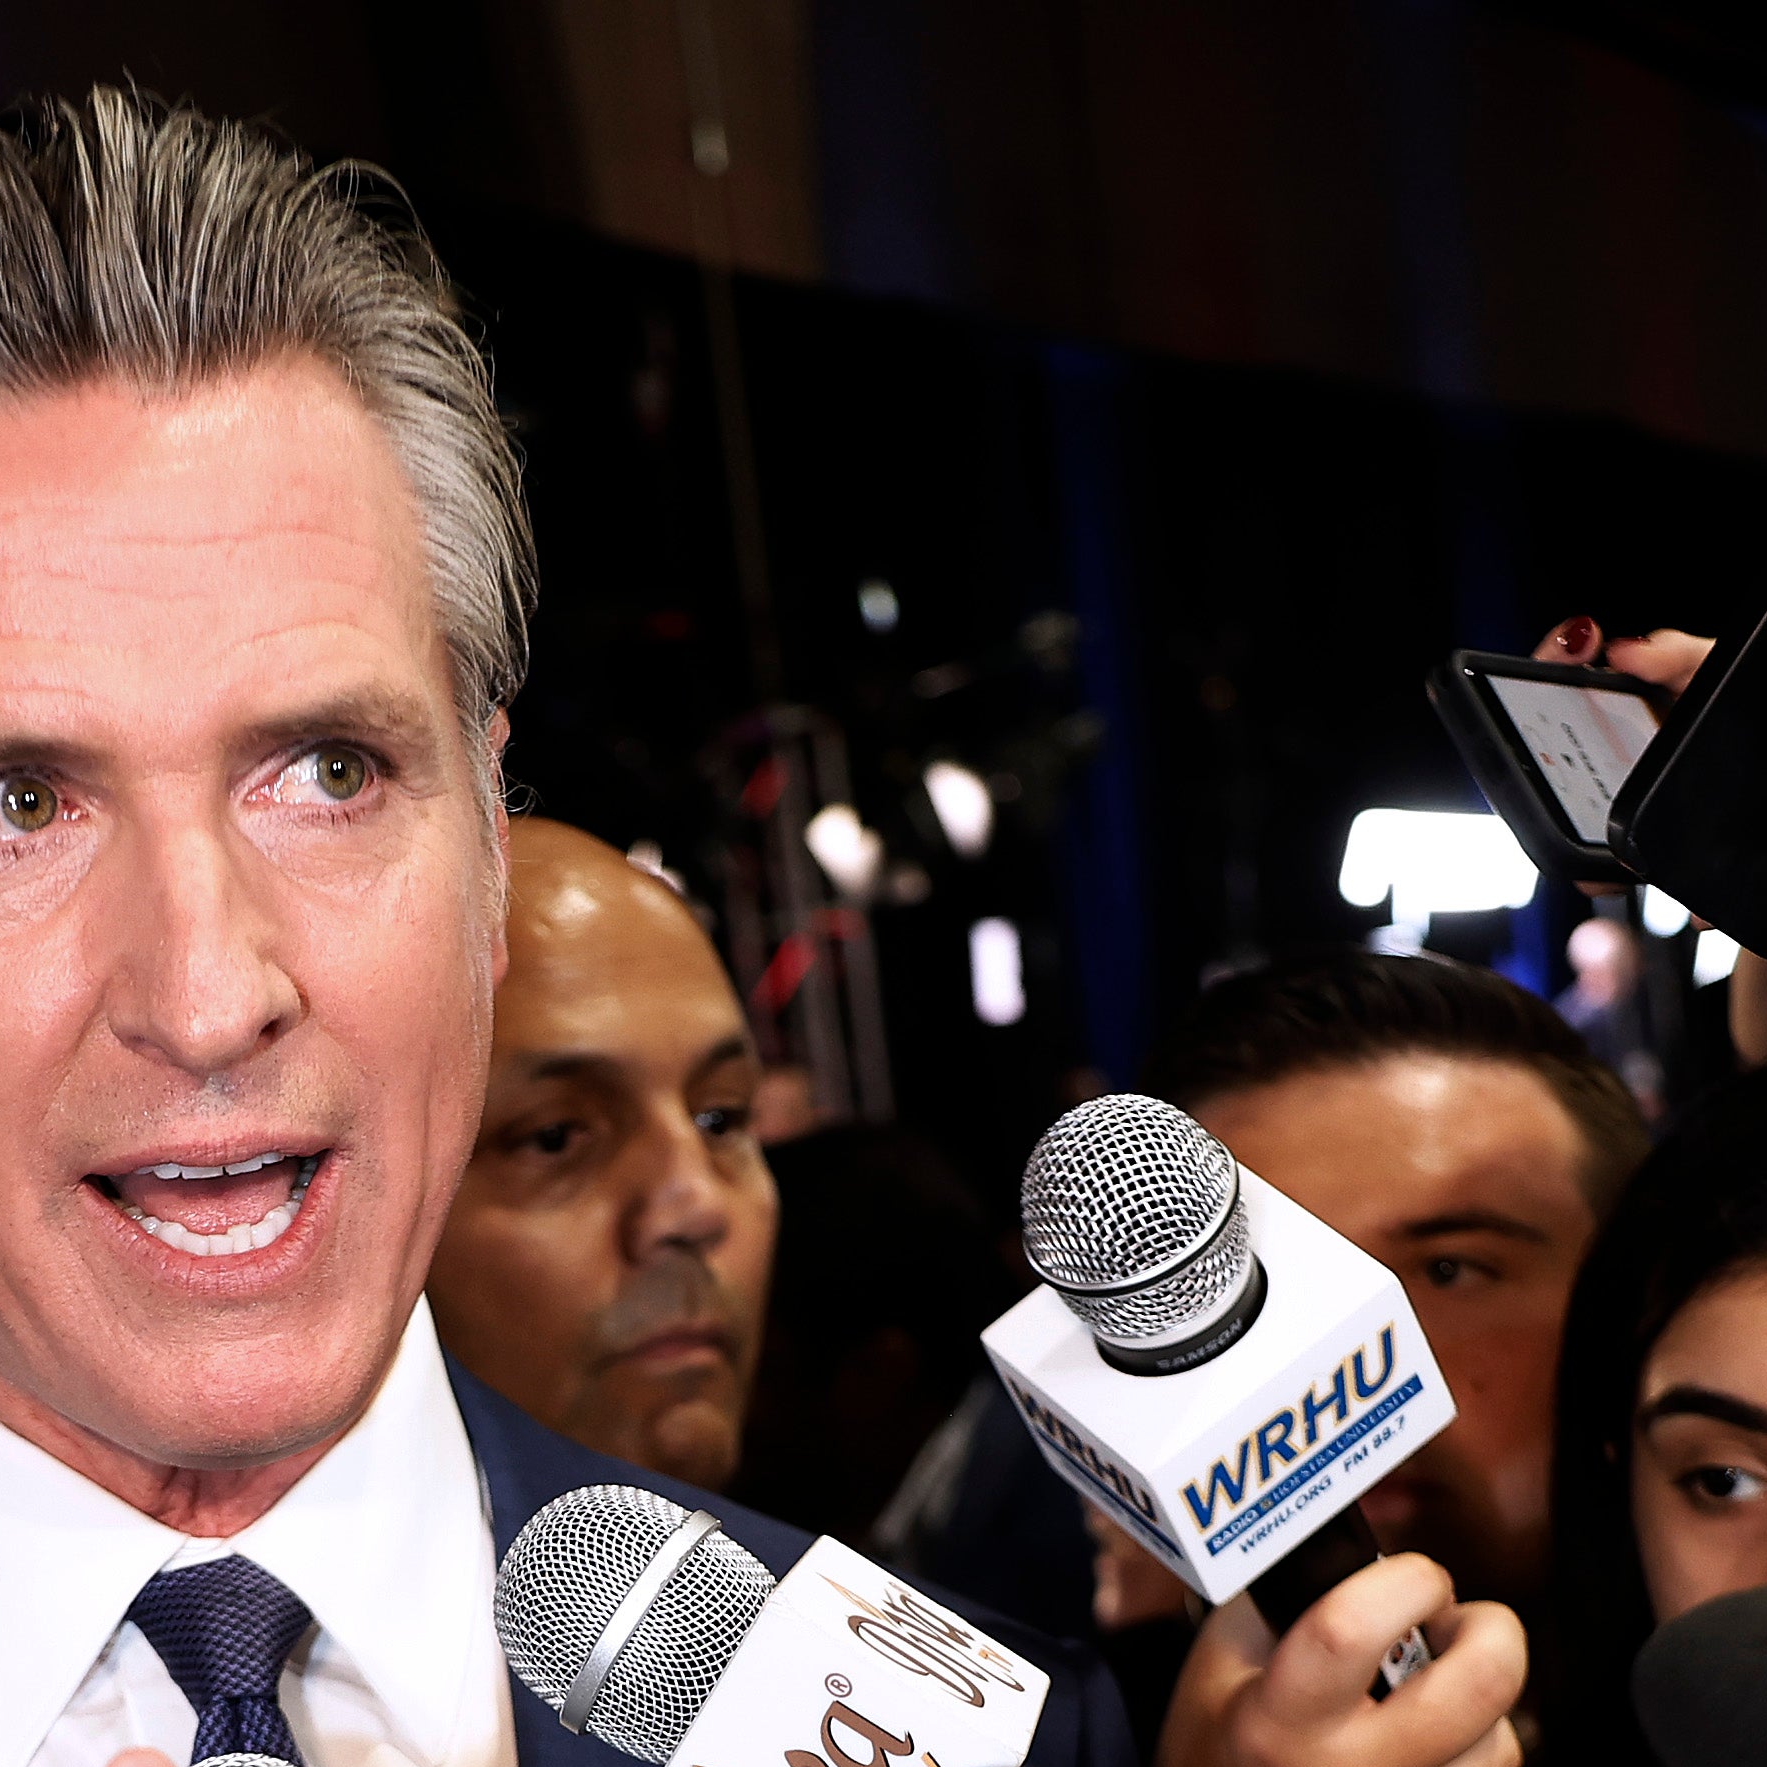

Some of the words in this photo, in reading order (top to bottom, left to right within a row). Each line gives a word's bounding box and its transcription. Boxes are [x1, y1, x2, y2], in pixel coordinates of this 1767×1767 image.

[1178, 1320, 1396, 1534] WRHU
[1212, 1507, 1259, 1549] RADIO
[1272, 1449, 1337, 1500] HOFSTRA
[1336, 1384, 1416, 1449] UNIVERSITY
[1239, 1475, 1332, 1554] WRHU.ORG
[1343, 1446, 1369, 1473] FM
[1372, 1415, 1406, 1450] 88.7
